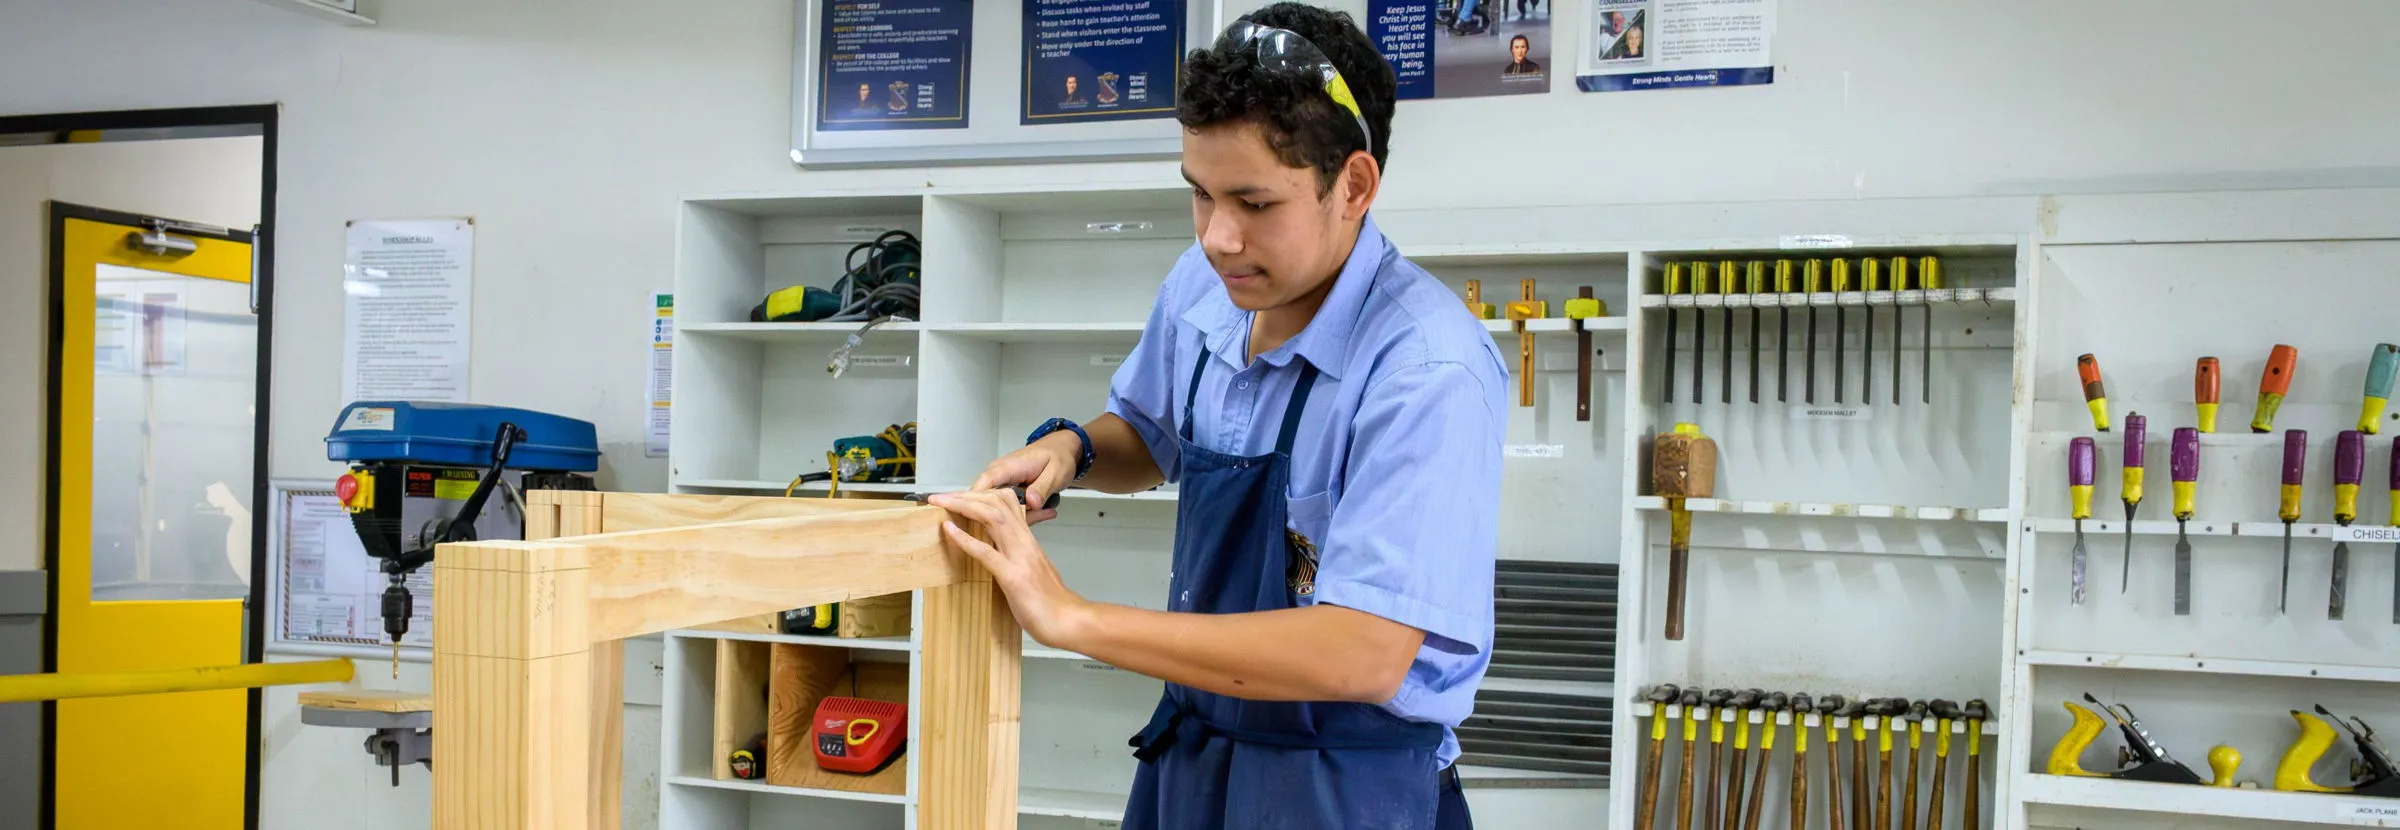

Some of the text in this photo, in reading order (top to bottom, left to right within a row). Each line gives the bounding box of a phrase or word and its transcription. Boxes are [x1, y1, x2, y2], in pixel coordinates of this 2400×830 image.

[1387, 5, 1426, 15] Keep Jesus
[1085, 17, 1098, 26] gain
[1100, 15, 1129, 24] teacher's
[1131, 13, 1159, 21] attention
[1379, 15, 1400, 24] Christ
[1409, 15, 1426, 23] your
[1382, 35, 1396, 44] you
[1398, 32, 1410, 41] will
[1059, 42, 1072, 50] only
[1106, 38, 1134, 46] direction
[1400, 42, 1416, 51] face
[1418, 40, 1424, 48] in
[1402, 60, 1424, 69] being.
[447, 470, 475, 479] WARNING
[2353, 529, 2400, 540] CHISEL
